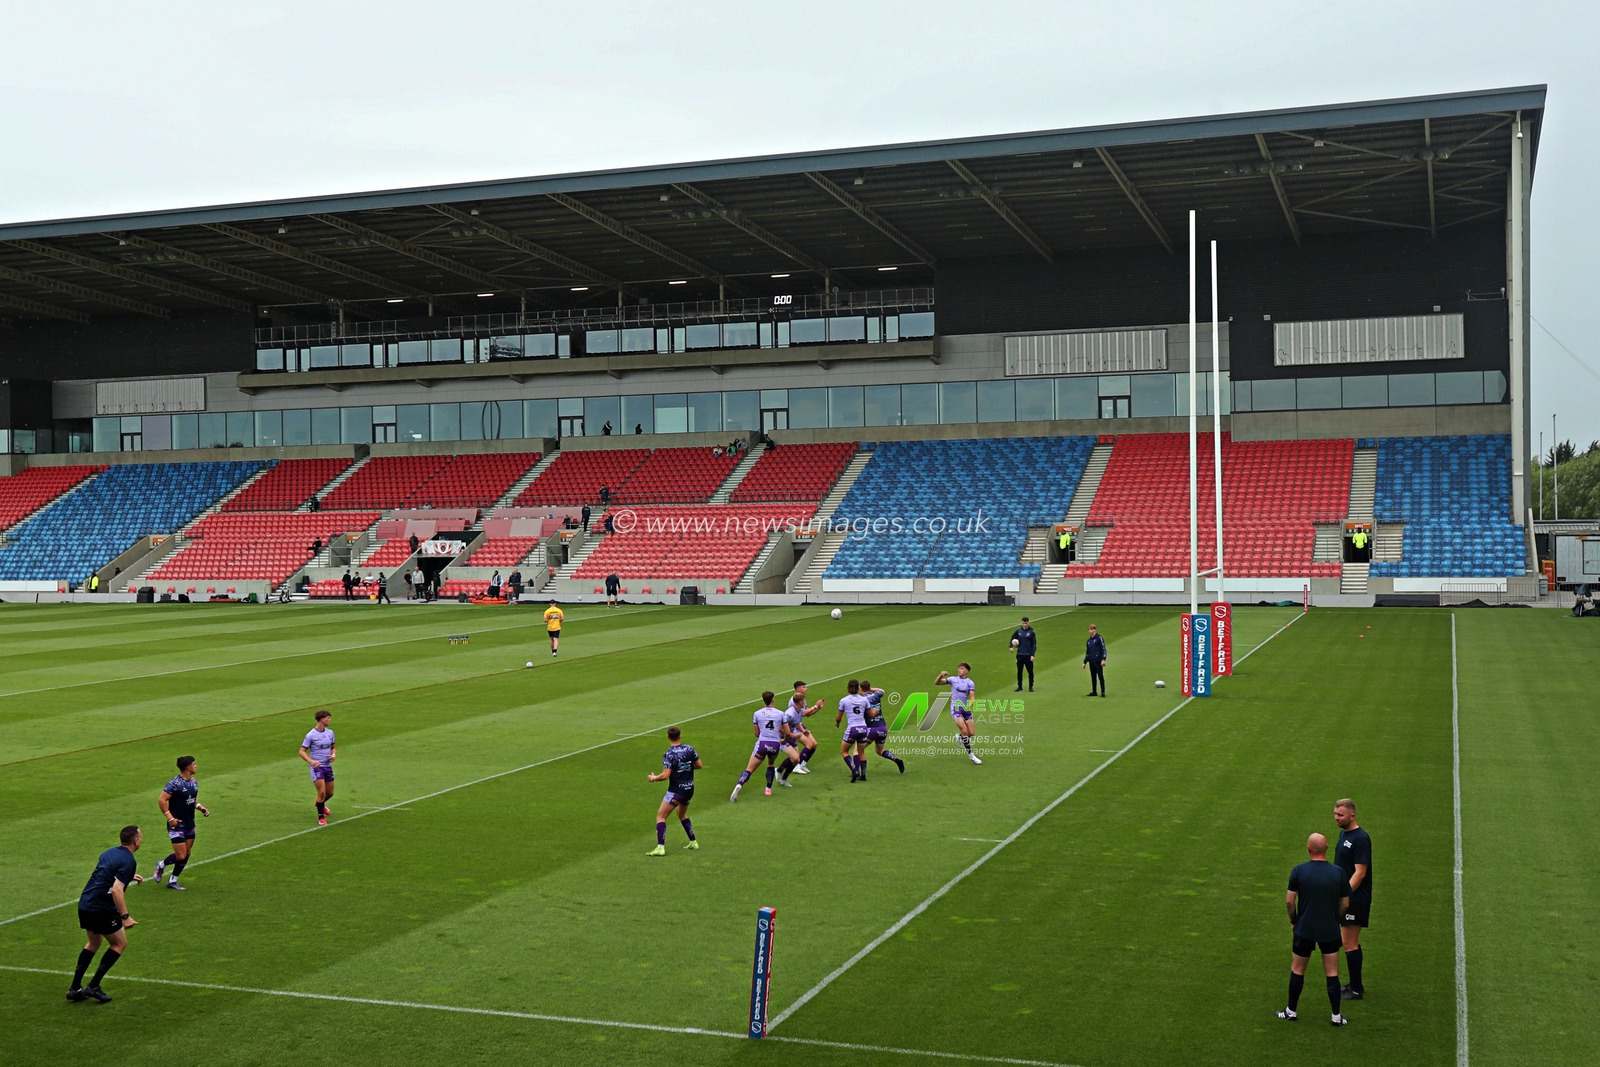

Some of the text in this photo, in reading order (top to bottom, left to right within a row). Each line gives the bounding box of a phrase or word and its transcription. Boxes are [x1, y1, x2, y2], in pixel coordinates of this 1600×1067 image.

[1217, 620, 1226, 673] BETFRED
[1197, 634, 1206, 694] BETFRED
[765, 720, 775, 730] 4
[852, 706, 861, 715] 6
